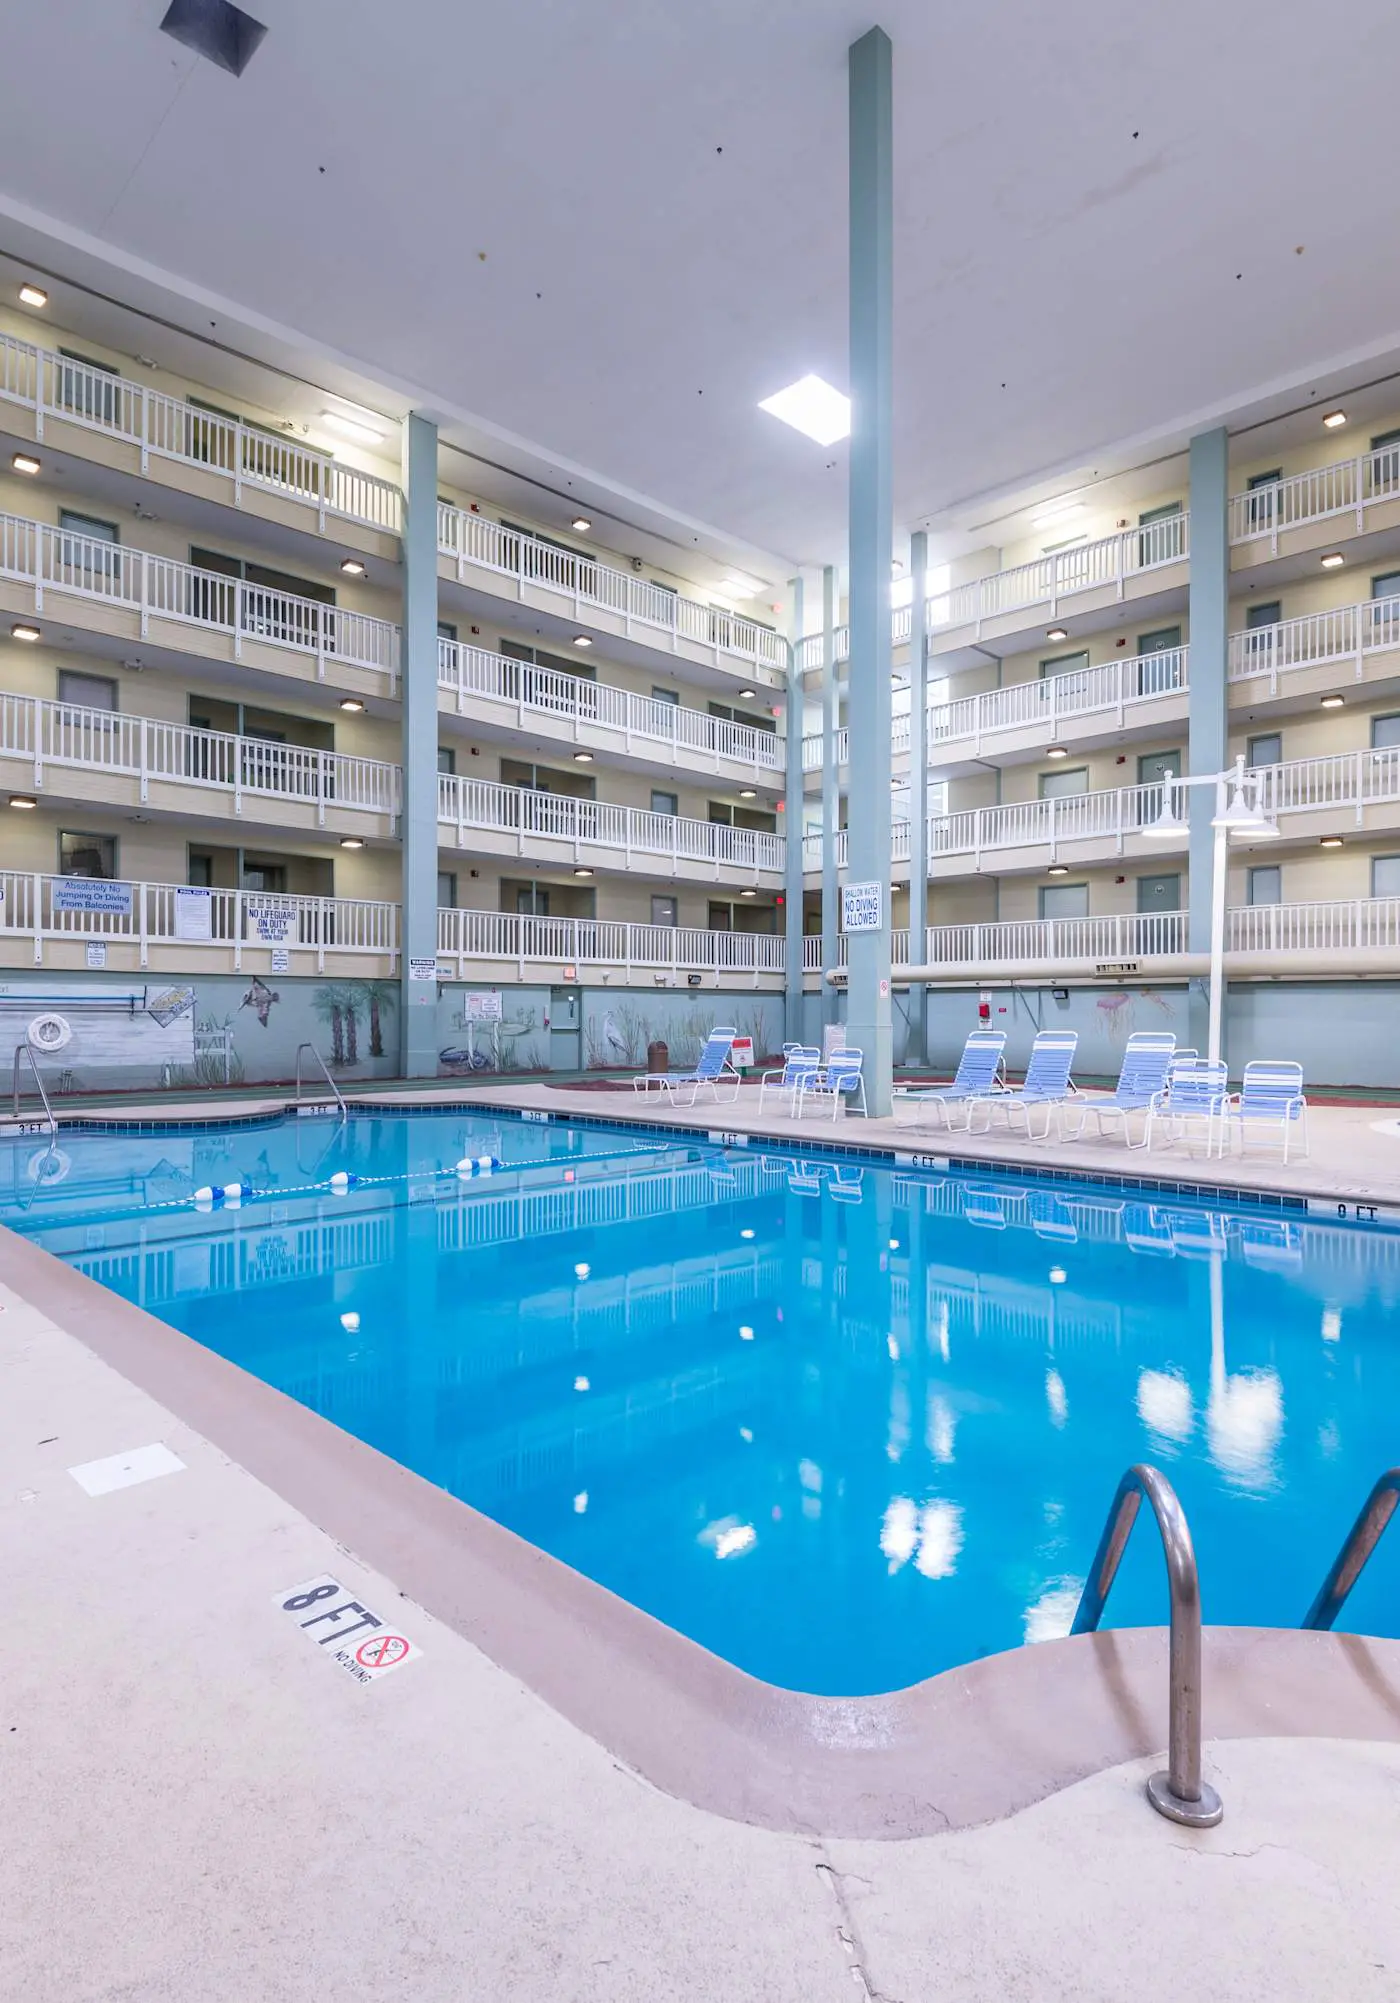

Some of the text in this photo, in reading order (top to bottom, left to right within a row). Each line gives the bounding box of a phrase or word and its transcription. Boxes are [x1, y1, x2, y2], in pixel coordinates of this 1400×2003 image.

[64, 881, 121, 893] Absolutely No
[845, 886, 878, 898] SHALLOW WATER
[56, 890, 130, 904] Jumping Or Diving
[61, 899, 125, 911] From Balconies
[845, 898, 878, 912] NO DIVING
[249, 909, 296, 920] NO LIFEGUARD
[846, 912, 878, 926] ALLOWED
[258, 919, 287, 928] ON DUTY
[282, 1584, 383, 1646] 8 FT
[335, 1650, 372, 1683] NO DIVING
